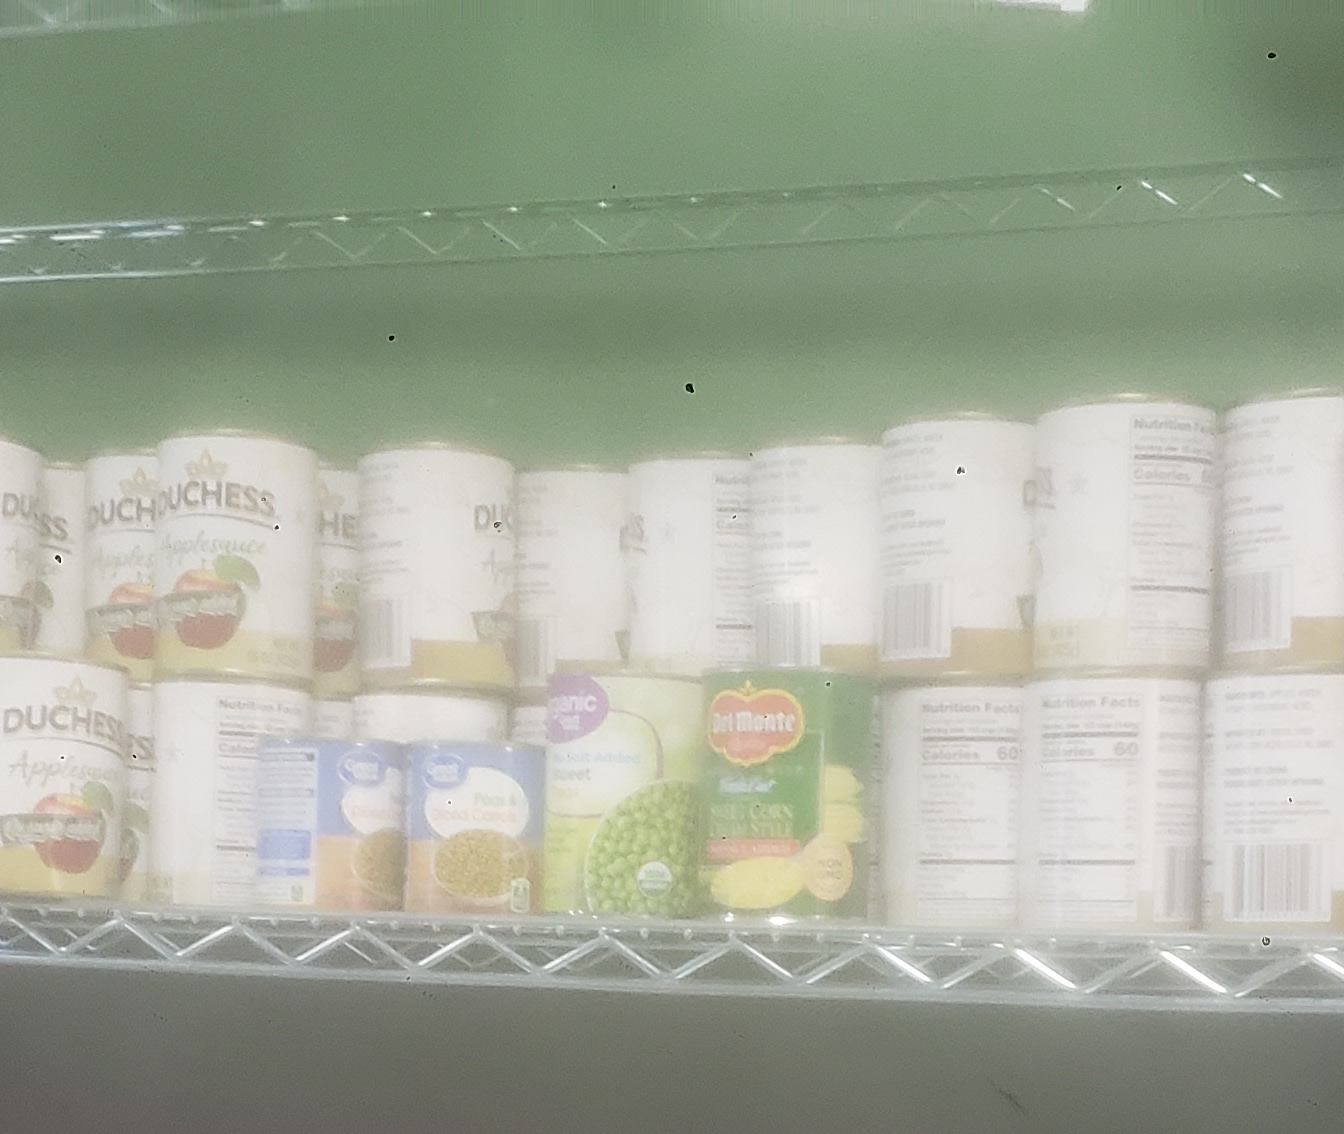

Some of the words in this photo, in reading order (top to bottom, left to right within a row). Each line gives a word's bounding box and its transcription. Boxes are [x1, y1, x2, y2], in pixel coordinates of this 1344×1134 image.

[157, 479, 277, 520] DUCHESS
[713, 712, 733, 732] Del
[736, 711, 796, 732] Monte
[1113, 742, 1140, 757] 60
